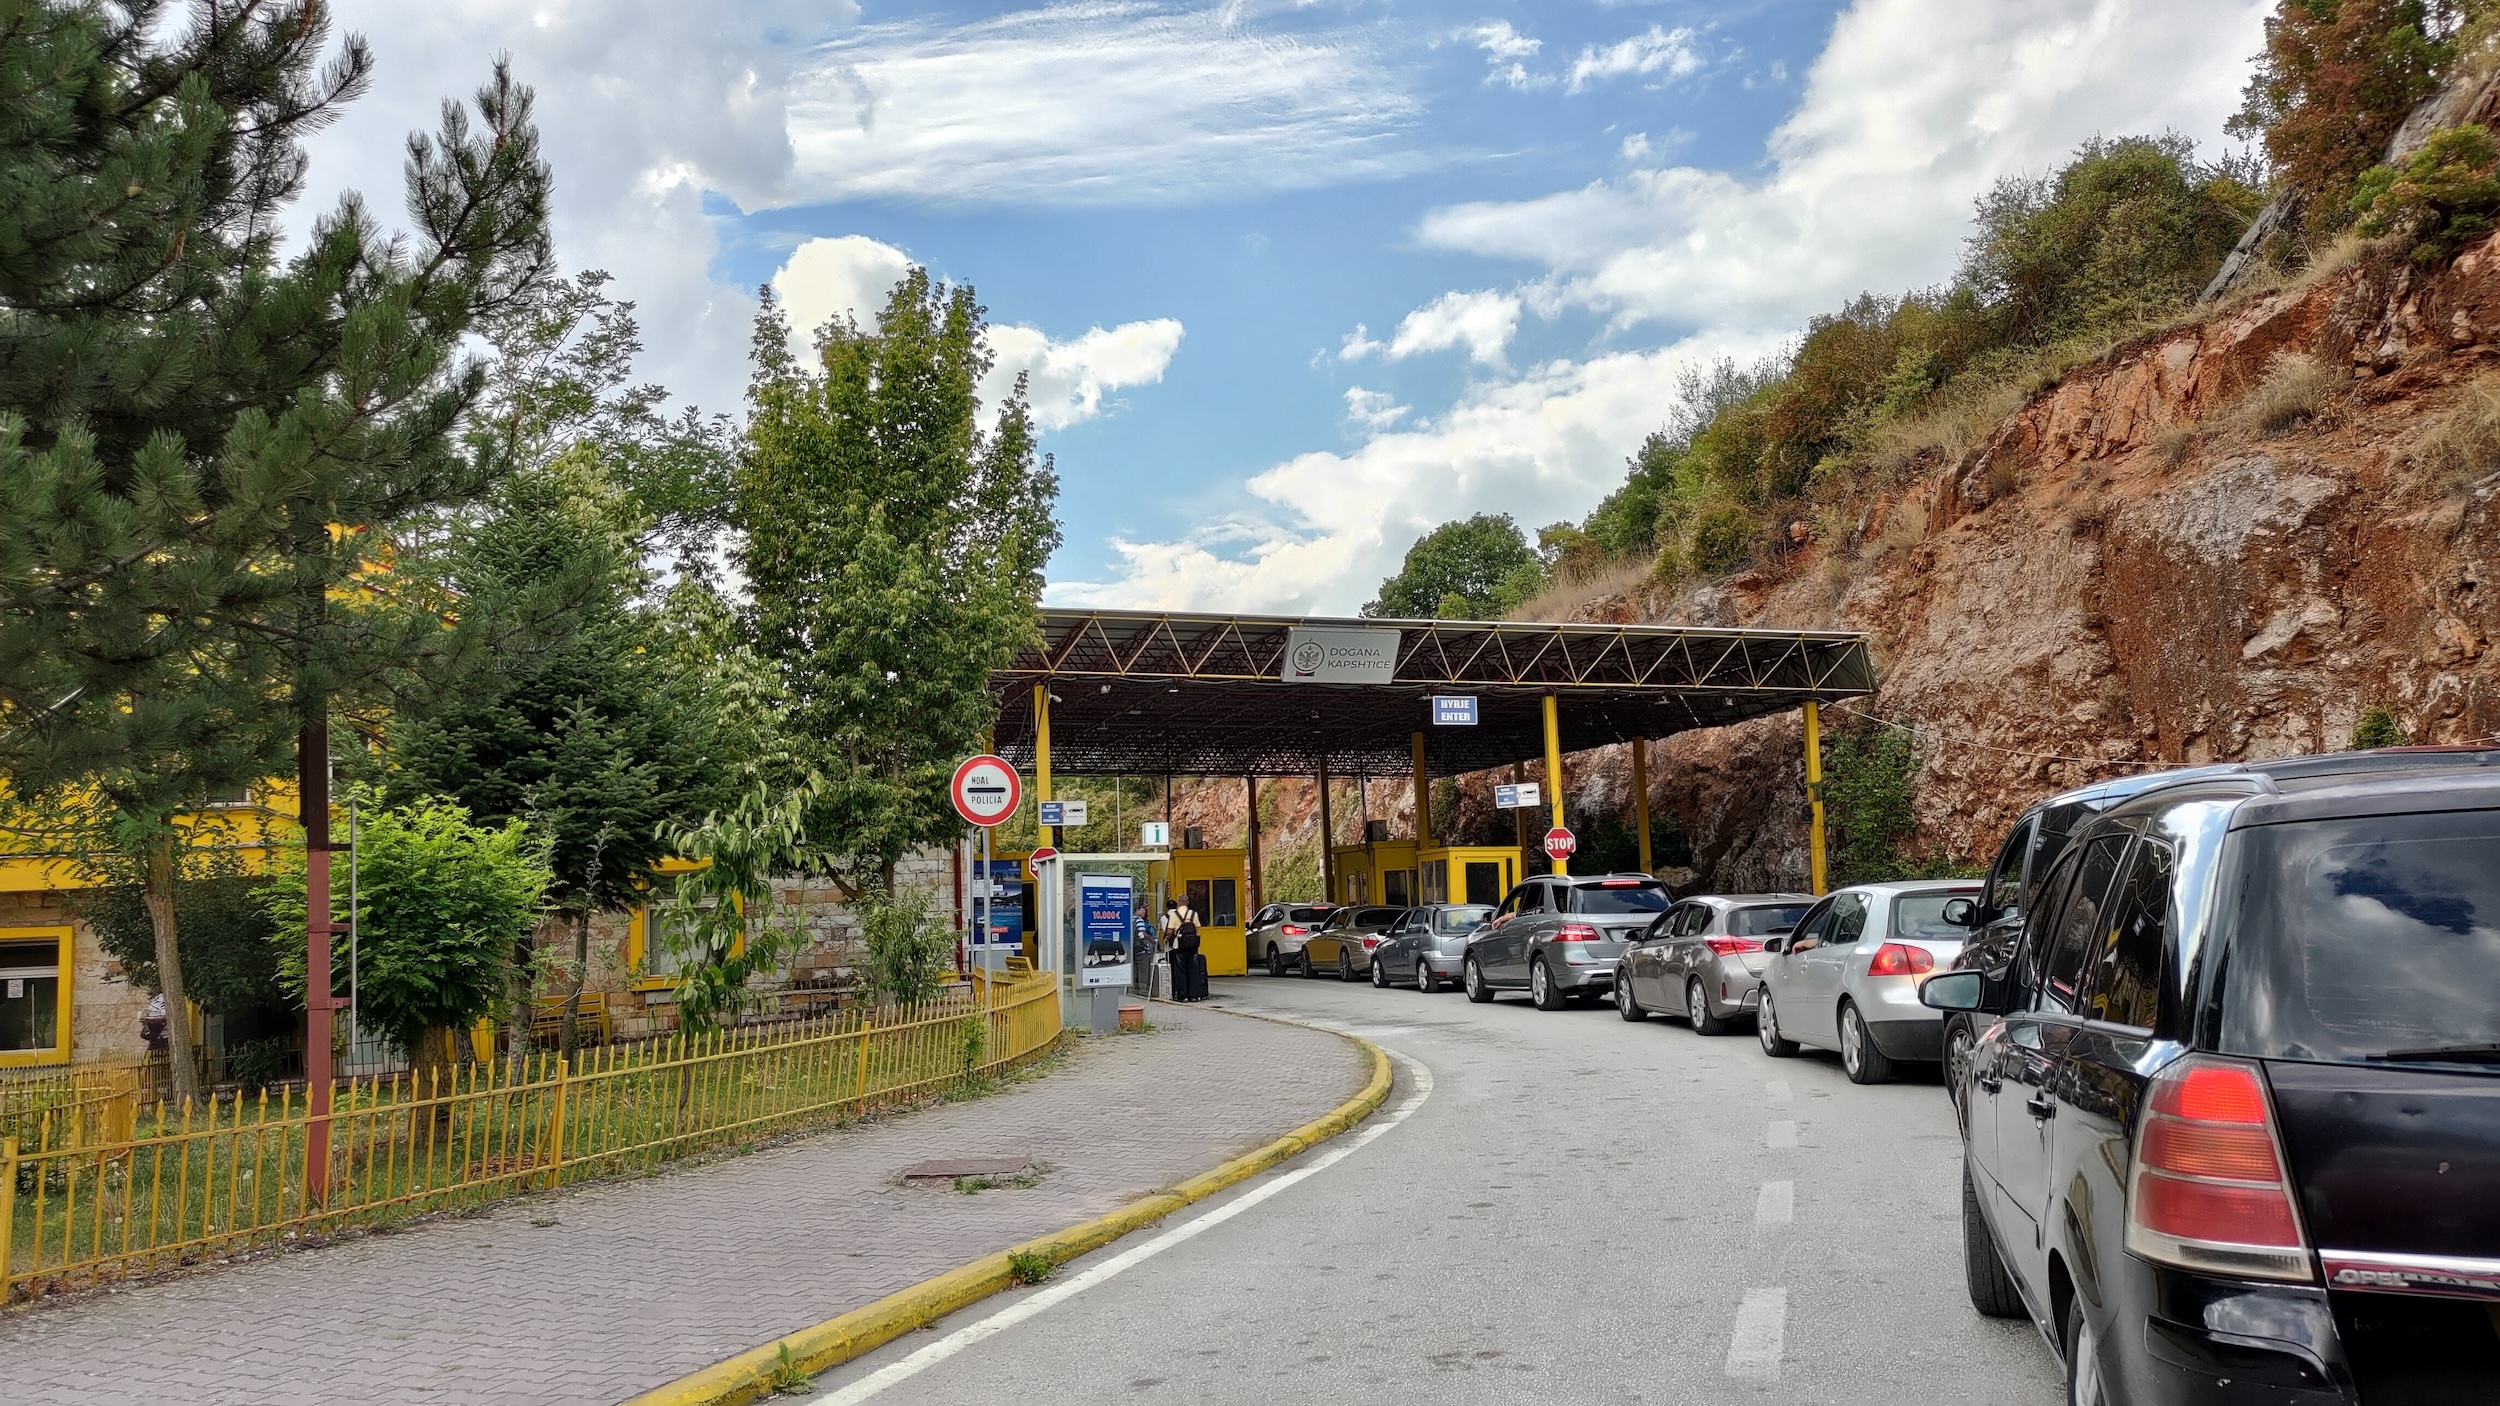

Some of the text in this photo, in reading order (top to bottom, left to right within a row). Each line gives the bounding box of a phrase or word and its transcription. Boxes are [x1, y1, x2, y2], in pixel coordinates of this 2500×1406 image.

[1330, 647, 1380, 657] DOGANA
[1327, 659, 1390, 669] KAPSHTICË
[1440, 699, 1470, 709] HYRJE
[1441, 712, 1470, 721] ENTER
[971, 796, 1002, 805] POLICIA
[1547, 837, 1573, 850] STOP
[2334, 1268, 2409, 1287] OPEL
